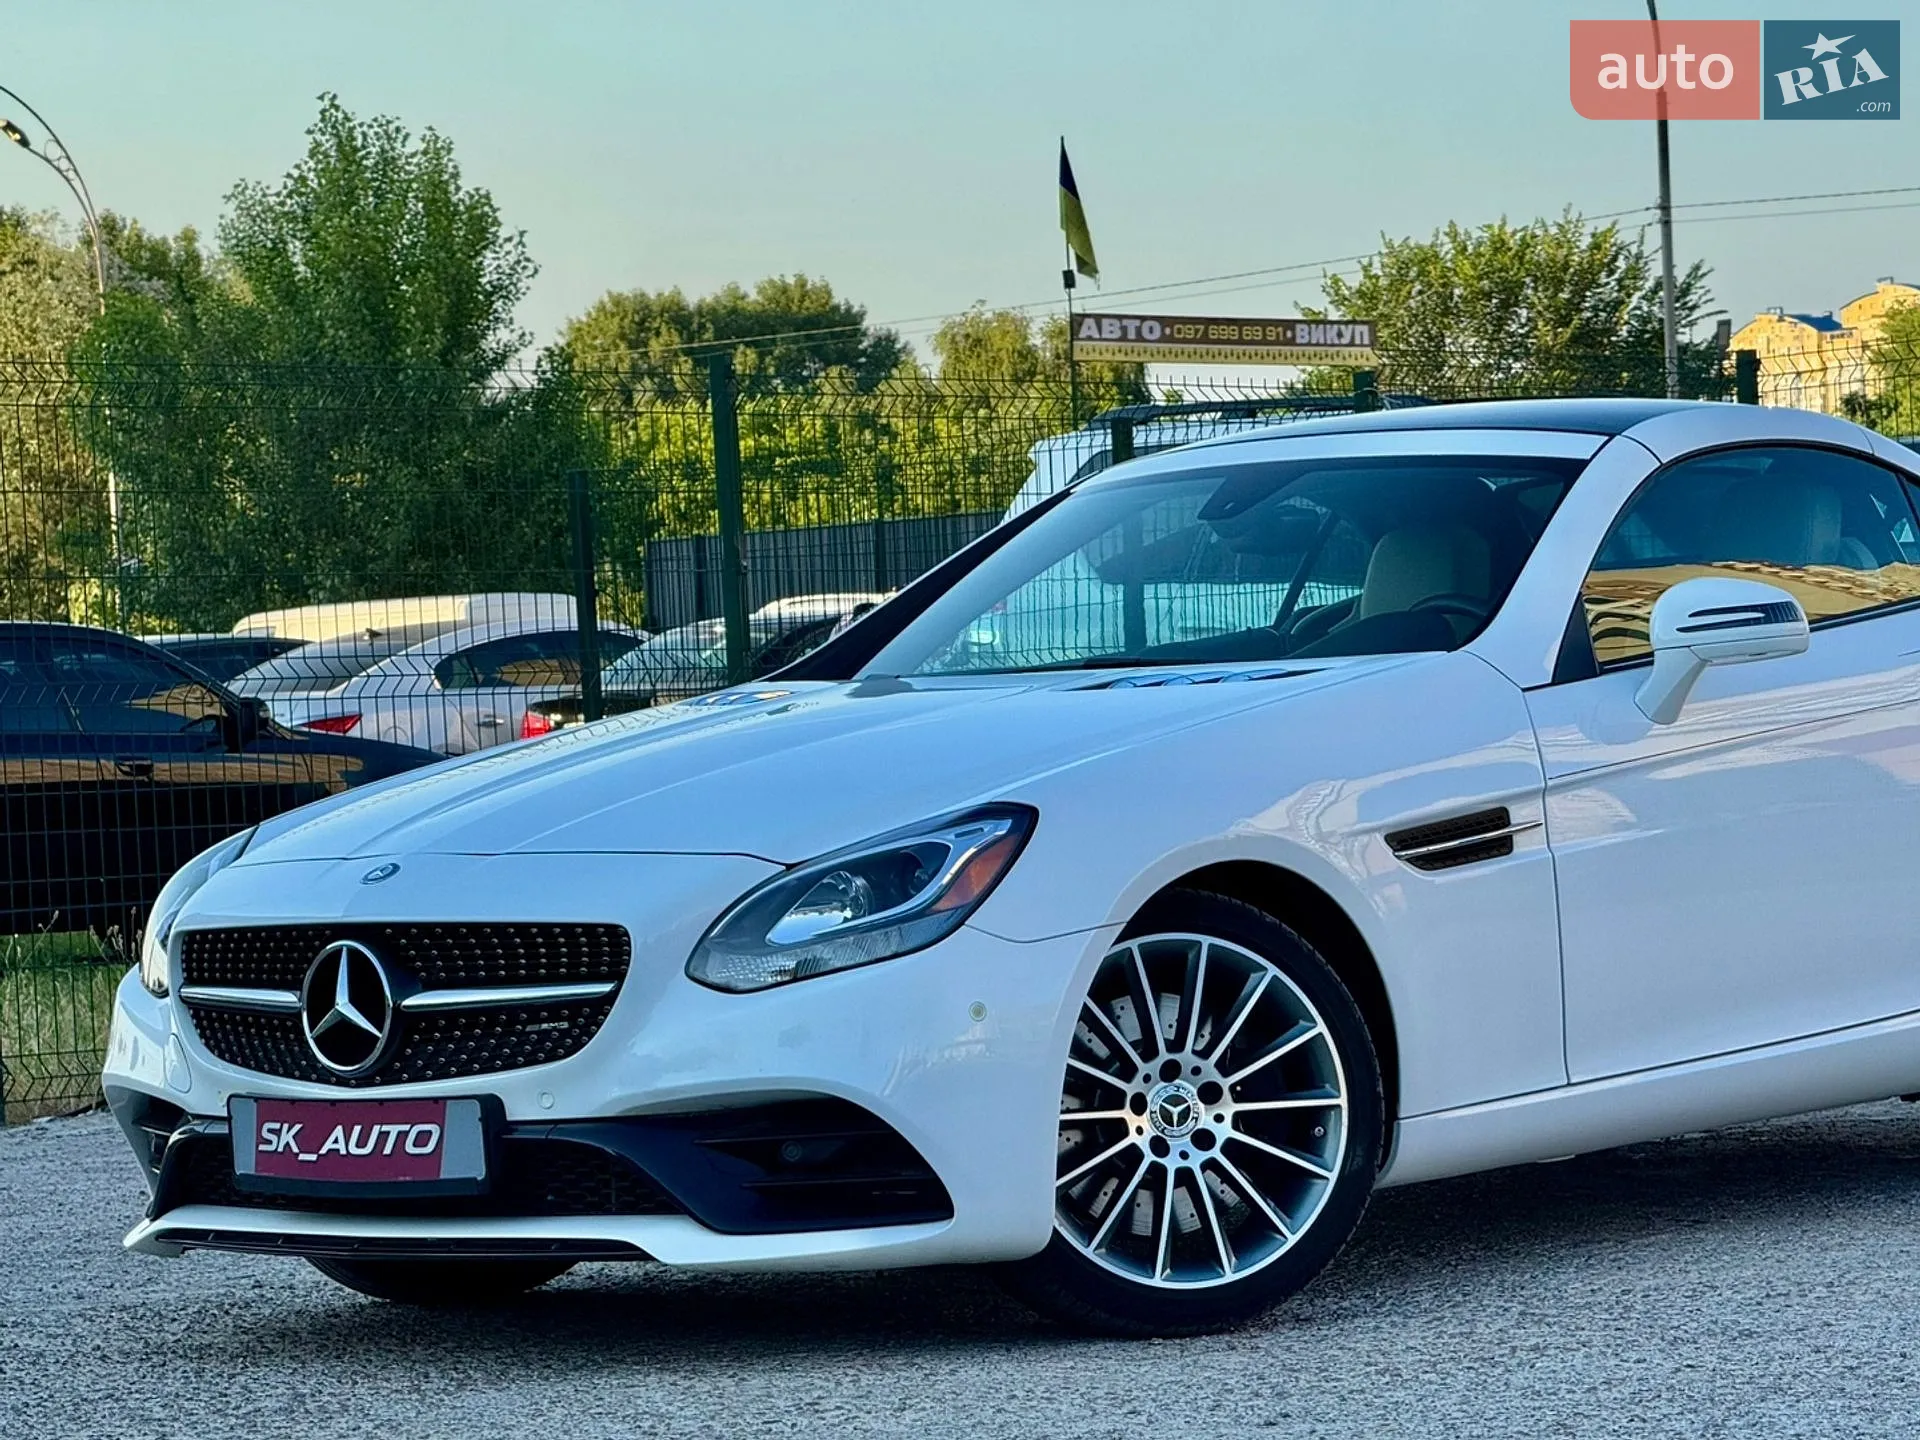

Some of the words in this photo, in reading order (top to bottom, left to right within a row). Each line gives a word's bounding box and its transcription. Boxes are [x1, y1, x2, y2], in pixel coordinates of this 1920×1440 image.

[1078, 317, 1161, 340] АВТО
[1173, 323, 1205, 339] 097
[1208, 325, 1239, 340] 699
[1242, 325, 1263, 340] 69
[1266, 326, 1284, 341] 91
[1295, 323, 1370, 344] ВИКУП
[258, 1122, 441, 1162] SK_AUTO
